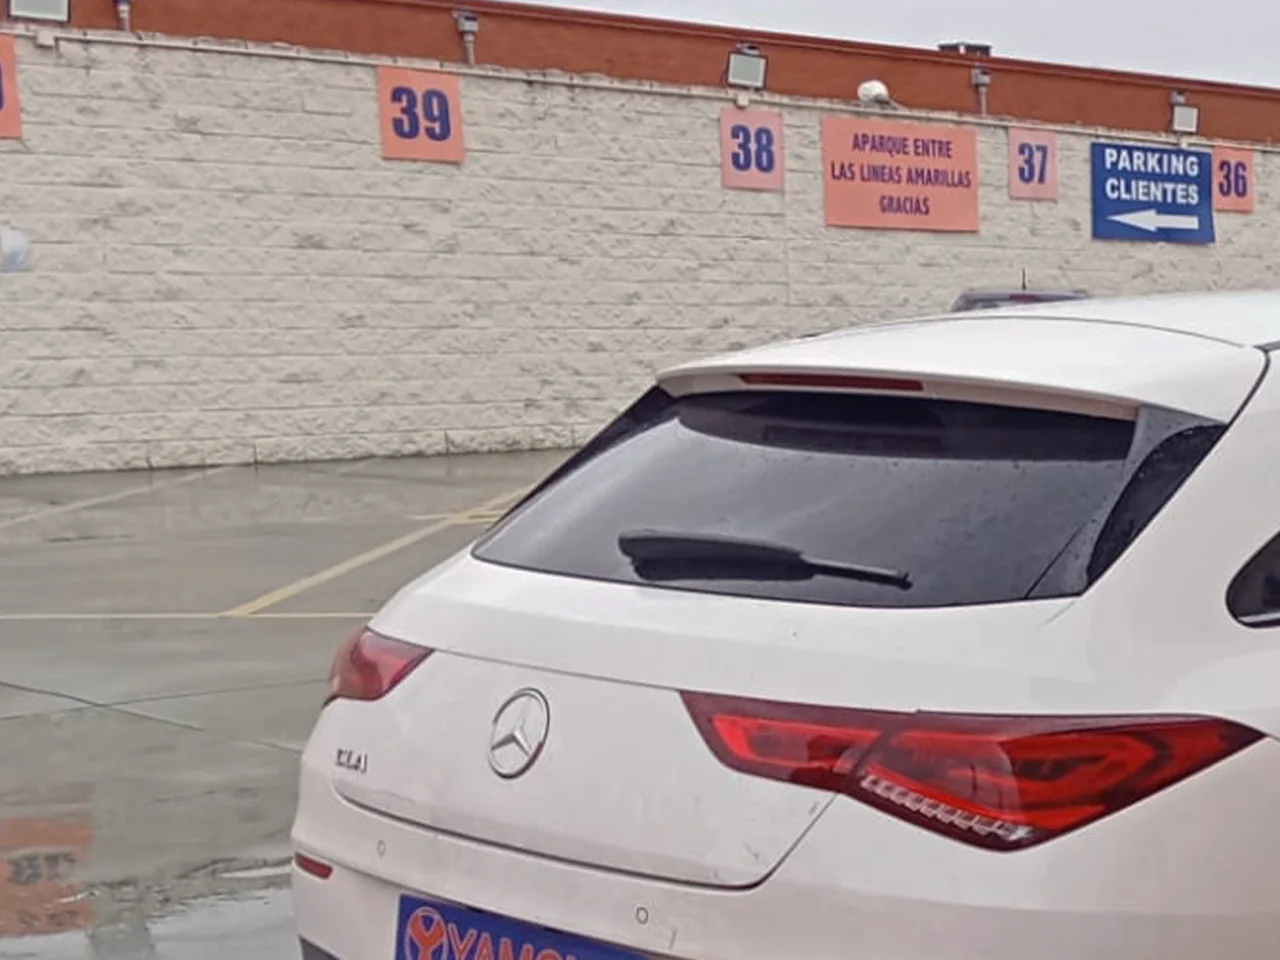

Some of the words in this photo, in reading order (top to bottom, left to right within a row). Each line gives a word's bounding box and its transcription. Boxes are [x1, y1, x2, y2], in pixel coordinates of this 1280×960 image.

[391, 87, 451, 141] 39
[730, 124, 775, 173] 38
[852, 132, 910, 157] APARQUE
[913, 138, 953, 159] ENTRE
[830, 161, 856, 181] LAS
[860, 163, 902, 184] LINEAS
[906, 167, 972, 188] AMARILLAS
[1018, 142, 1049, 185] 37
[1104, 147, 1200, 177] PARKING
[1105, 177, 1200, 206] CLIENTES
[1218, 160, 1248, 198] 36
[879, 194, 931, 216] GRACIAS
